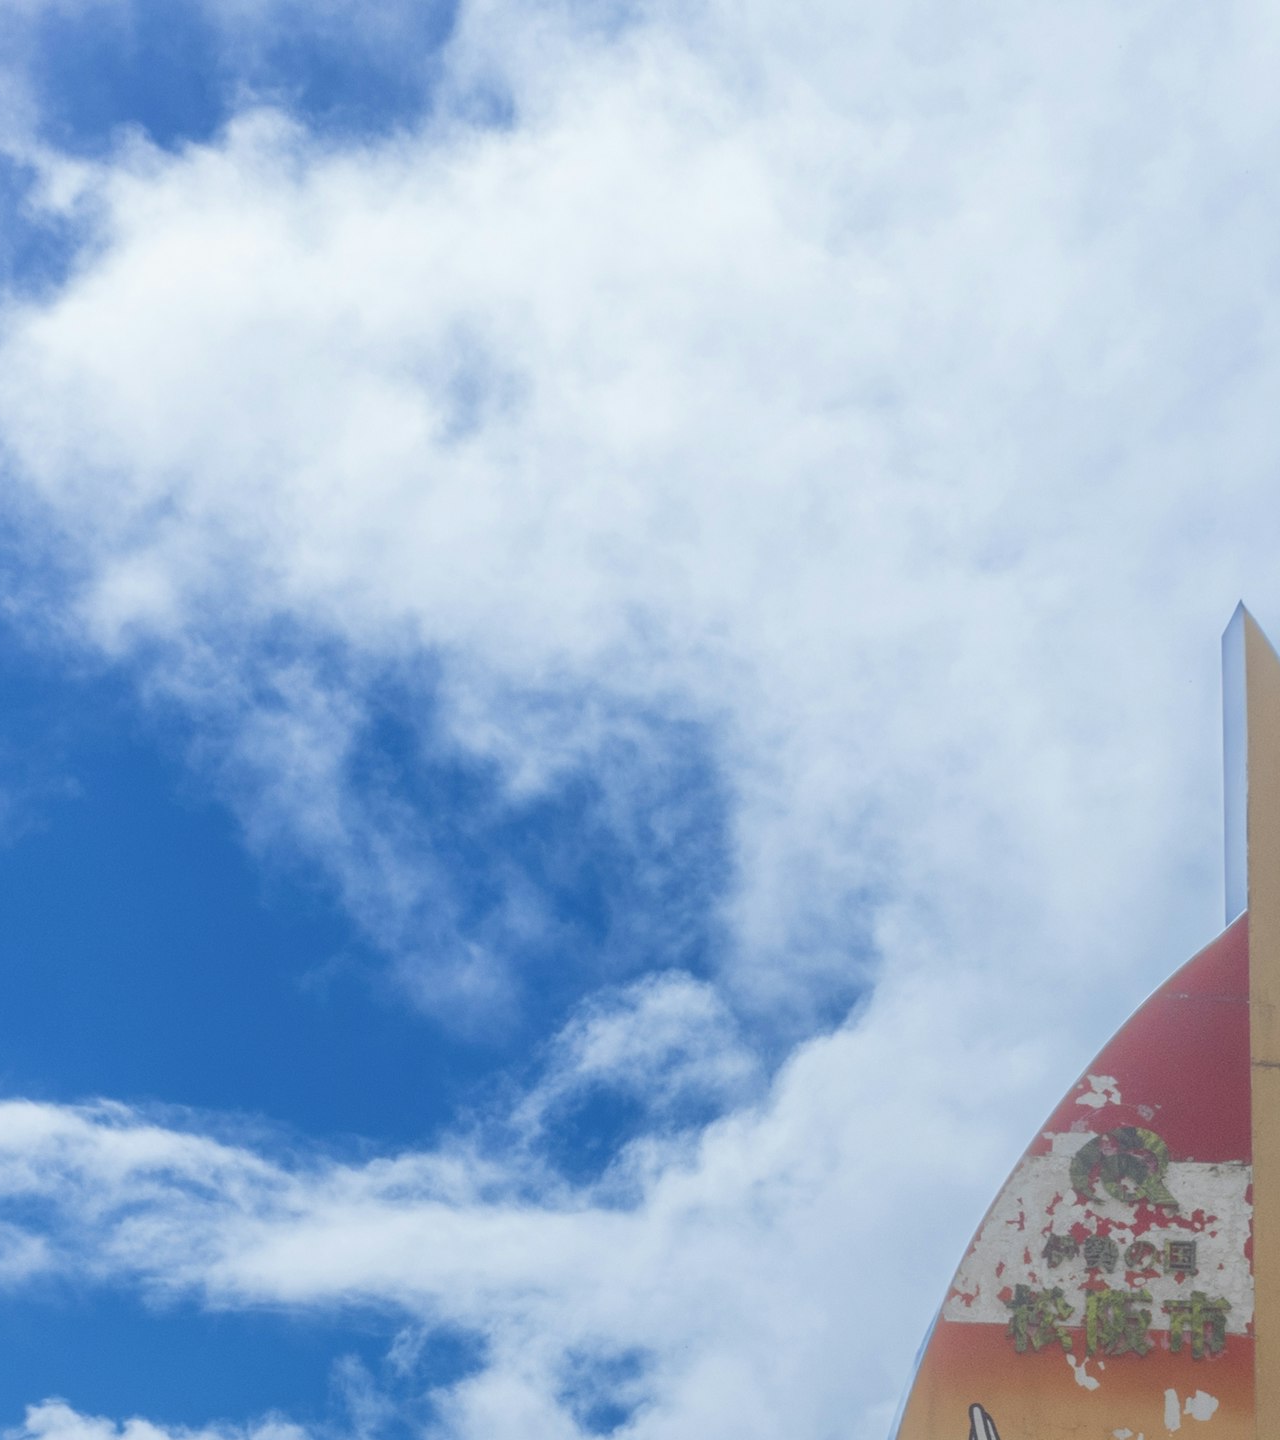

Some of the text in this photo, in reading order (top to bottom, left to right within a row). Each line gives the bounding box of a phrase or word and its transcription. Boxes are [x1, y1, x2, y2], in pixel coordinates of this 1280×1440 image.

[1041, 1233, 1197, 1275] 伊勢の国
[1006, 1283, 1232, 1360] 松阪市
